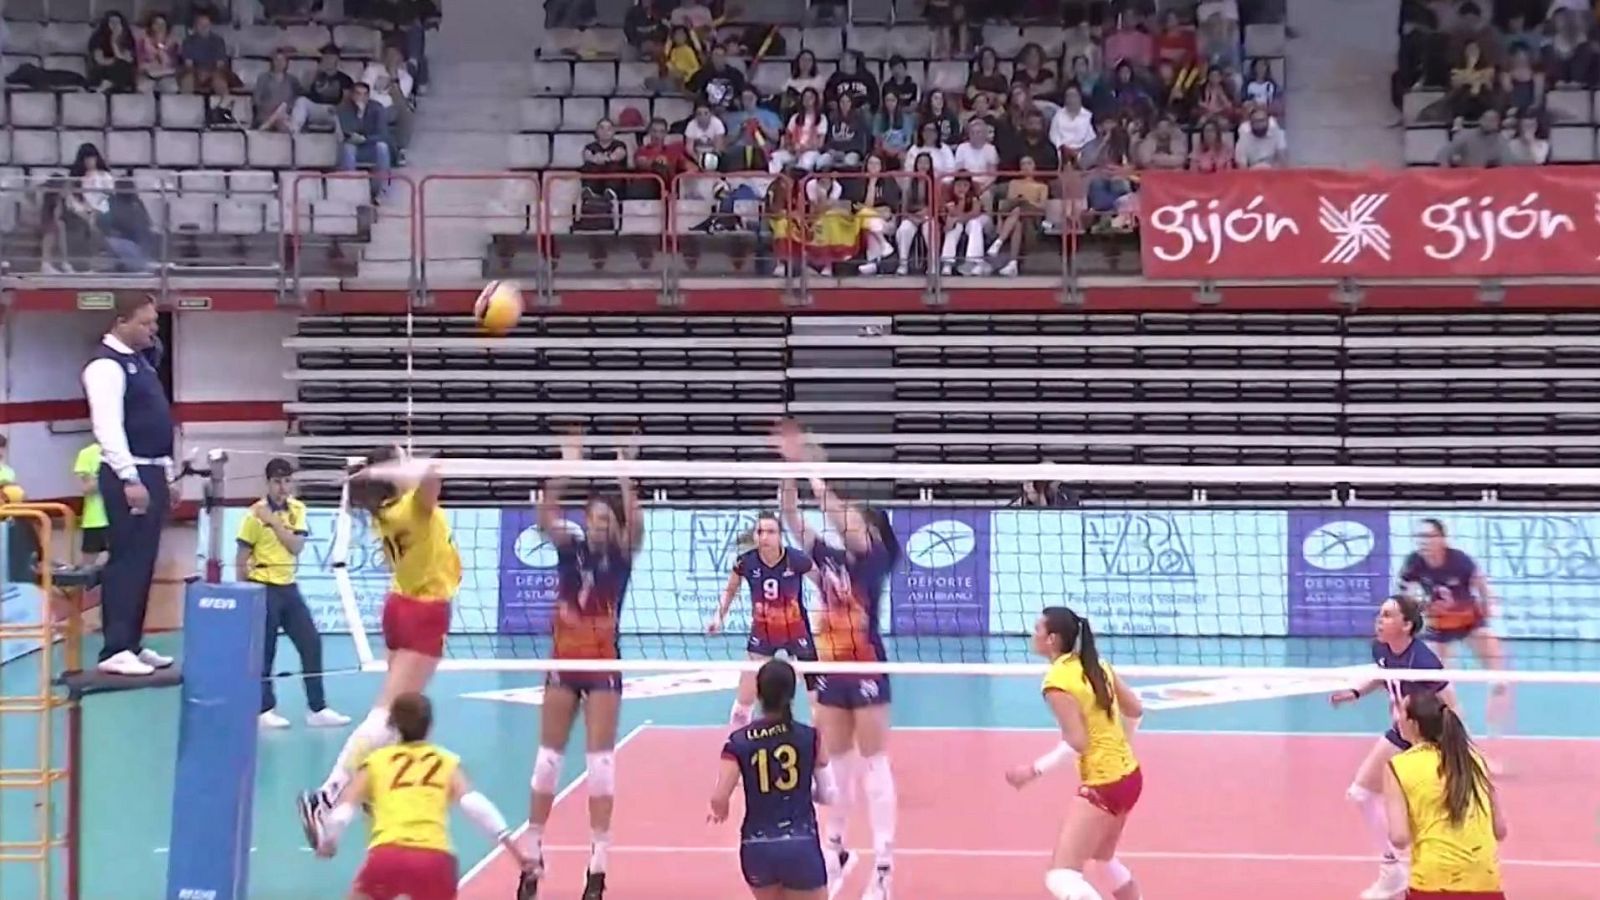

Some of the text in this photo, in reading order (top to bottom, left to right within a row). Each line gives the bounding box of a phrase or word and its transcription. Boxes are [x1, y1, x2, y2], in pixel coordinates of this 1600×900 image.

[1150, 194, 1300, 264] gijón
[1421, 191, 1577, 262] gijón
[762, 578, 779, 600] 9
[390, 751, 444, 791] 22
[751, 744, 799, 793] 13
